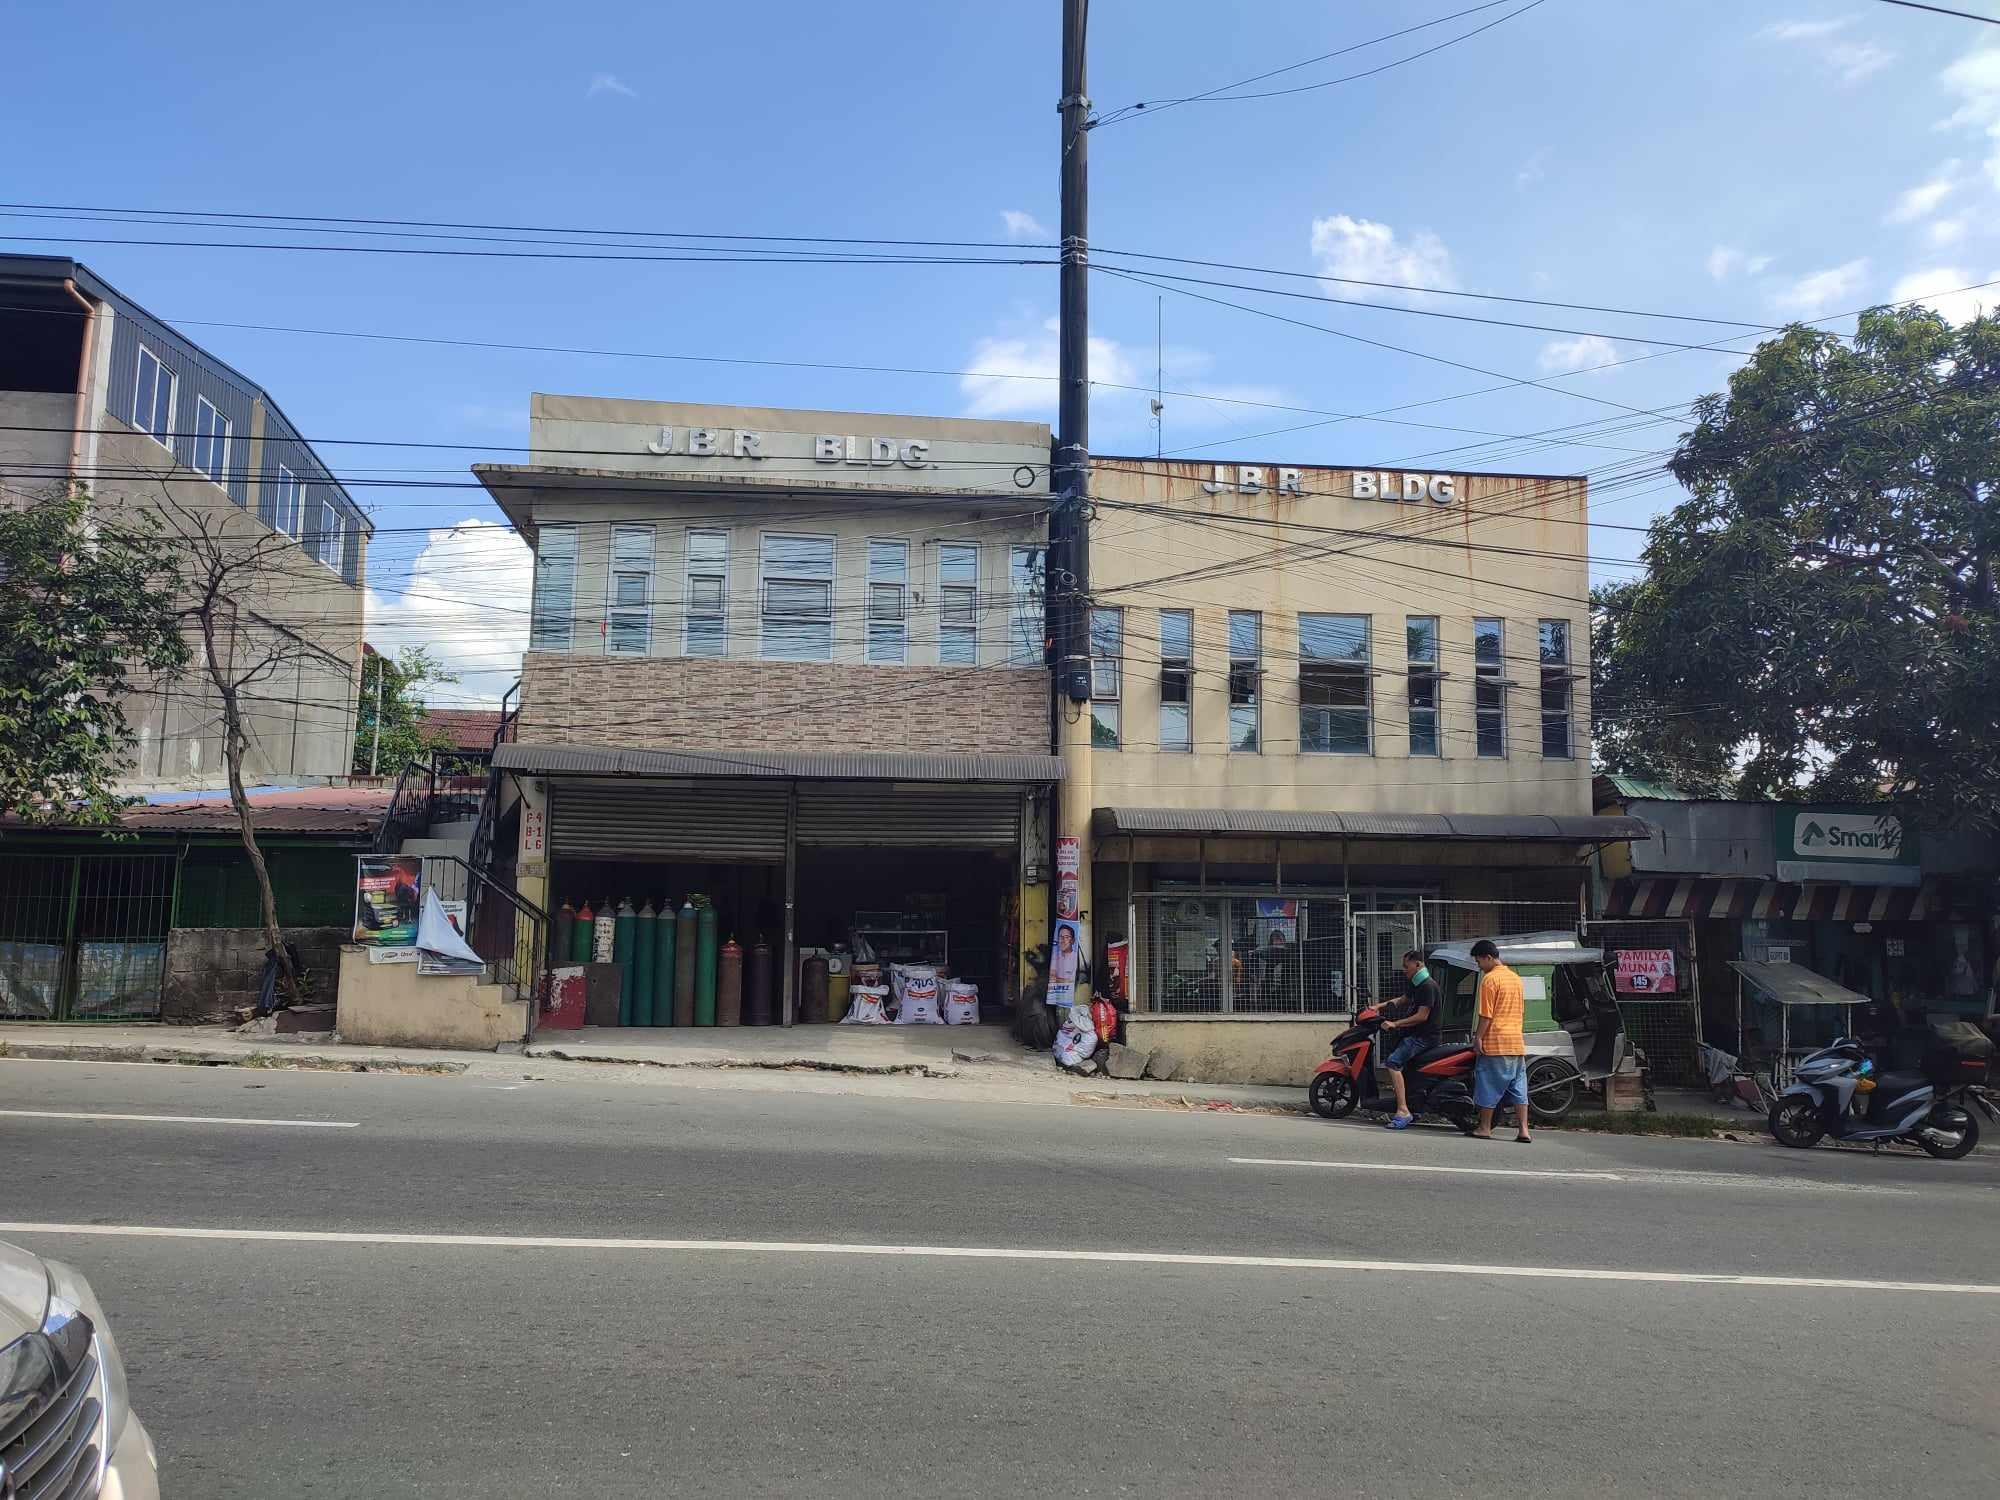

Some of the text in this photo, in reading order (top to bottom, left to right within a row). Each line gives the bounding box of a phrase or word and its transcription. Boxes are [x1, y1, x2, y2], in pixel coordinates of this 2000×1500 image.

[815, 433, 939, 469] BLDG.
[1351, 470, 1466, 504] BLDG.
[1616, 951, 1670, 961] PAMILYA
[1616, 963, 1657, 973] MUNA
[1632, 975, 1648, 986] 145
